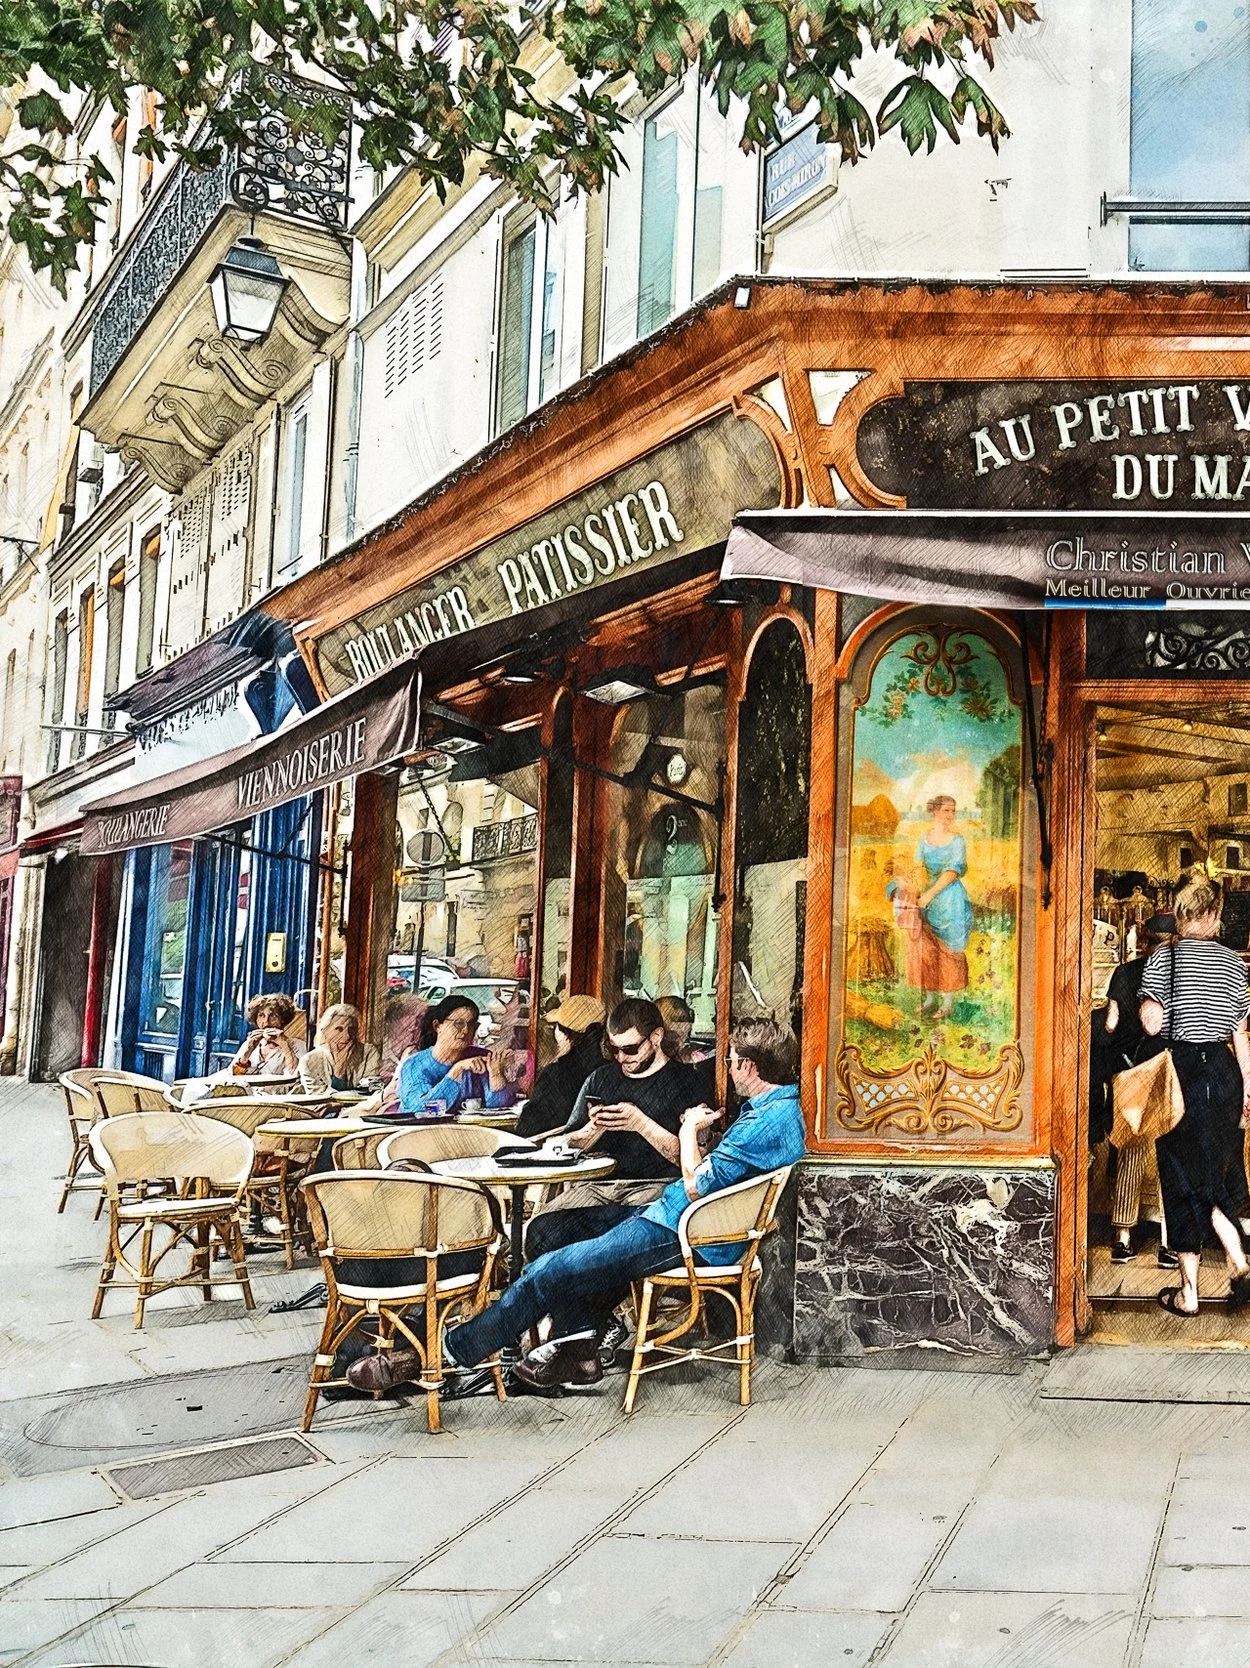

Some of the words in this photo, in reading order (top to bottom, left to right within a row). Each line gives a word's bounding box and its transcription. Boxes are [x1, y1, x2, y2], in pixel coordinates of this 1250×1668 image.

[969, 413, 1036, 477] AU
[1050, 384, 1200, 450] PETIT
[1111, 453, 1179, 501] DU
[497, 479, 685, 615] PATISSIER
[1046, 536, 1226, 574] Christian
[1045, 577, 1151, 598] Meilleur
[237, 717, 367, 810] VIENNOISERIE
